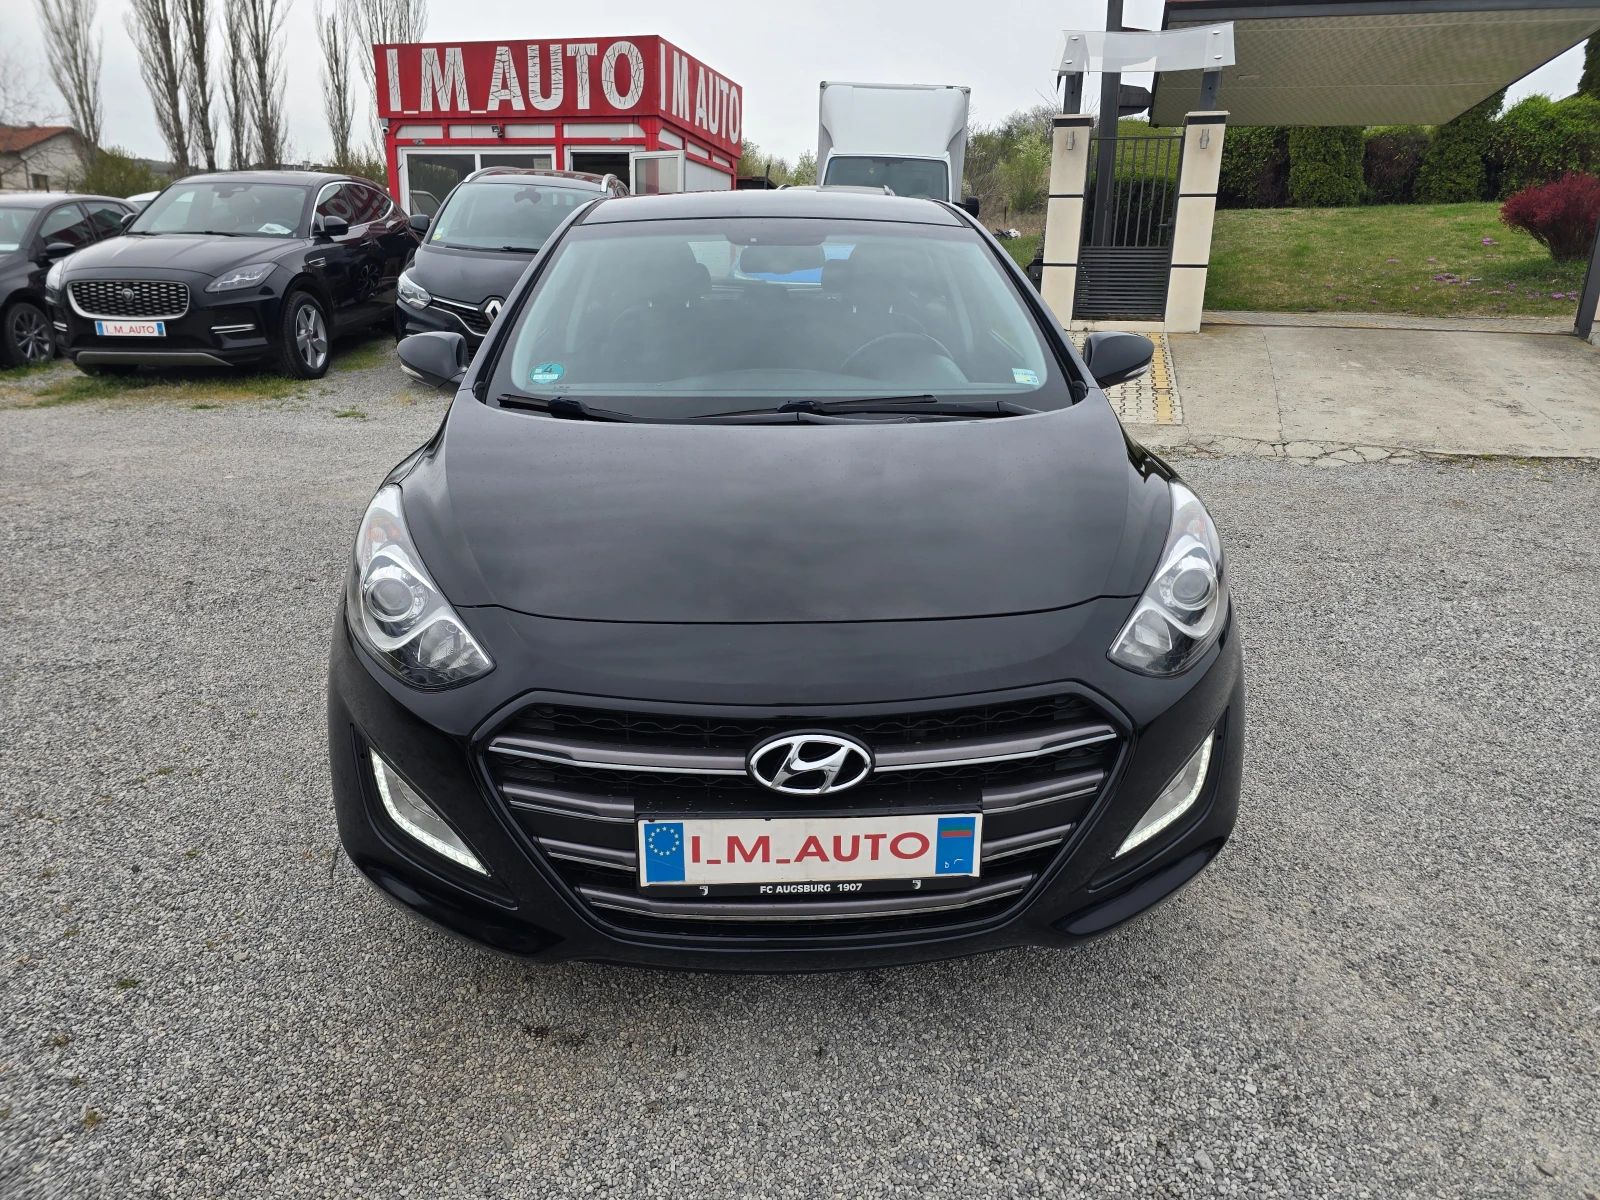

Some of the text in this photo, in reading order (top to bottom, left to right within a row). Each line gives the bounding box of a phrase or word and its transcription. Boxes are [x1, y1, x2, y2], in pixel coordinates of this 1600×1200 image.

[694, 65, 740, 145] AUTO
[542, 364, 554, 374] 4
[691, 831, 931, 866] I_M_AUTO
[759, 882, 863, 894] FC AUGSBURG 1907
